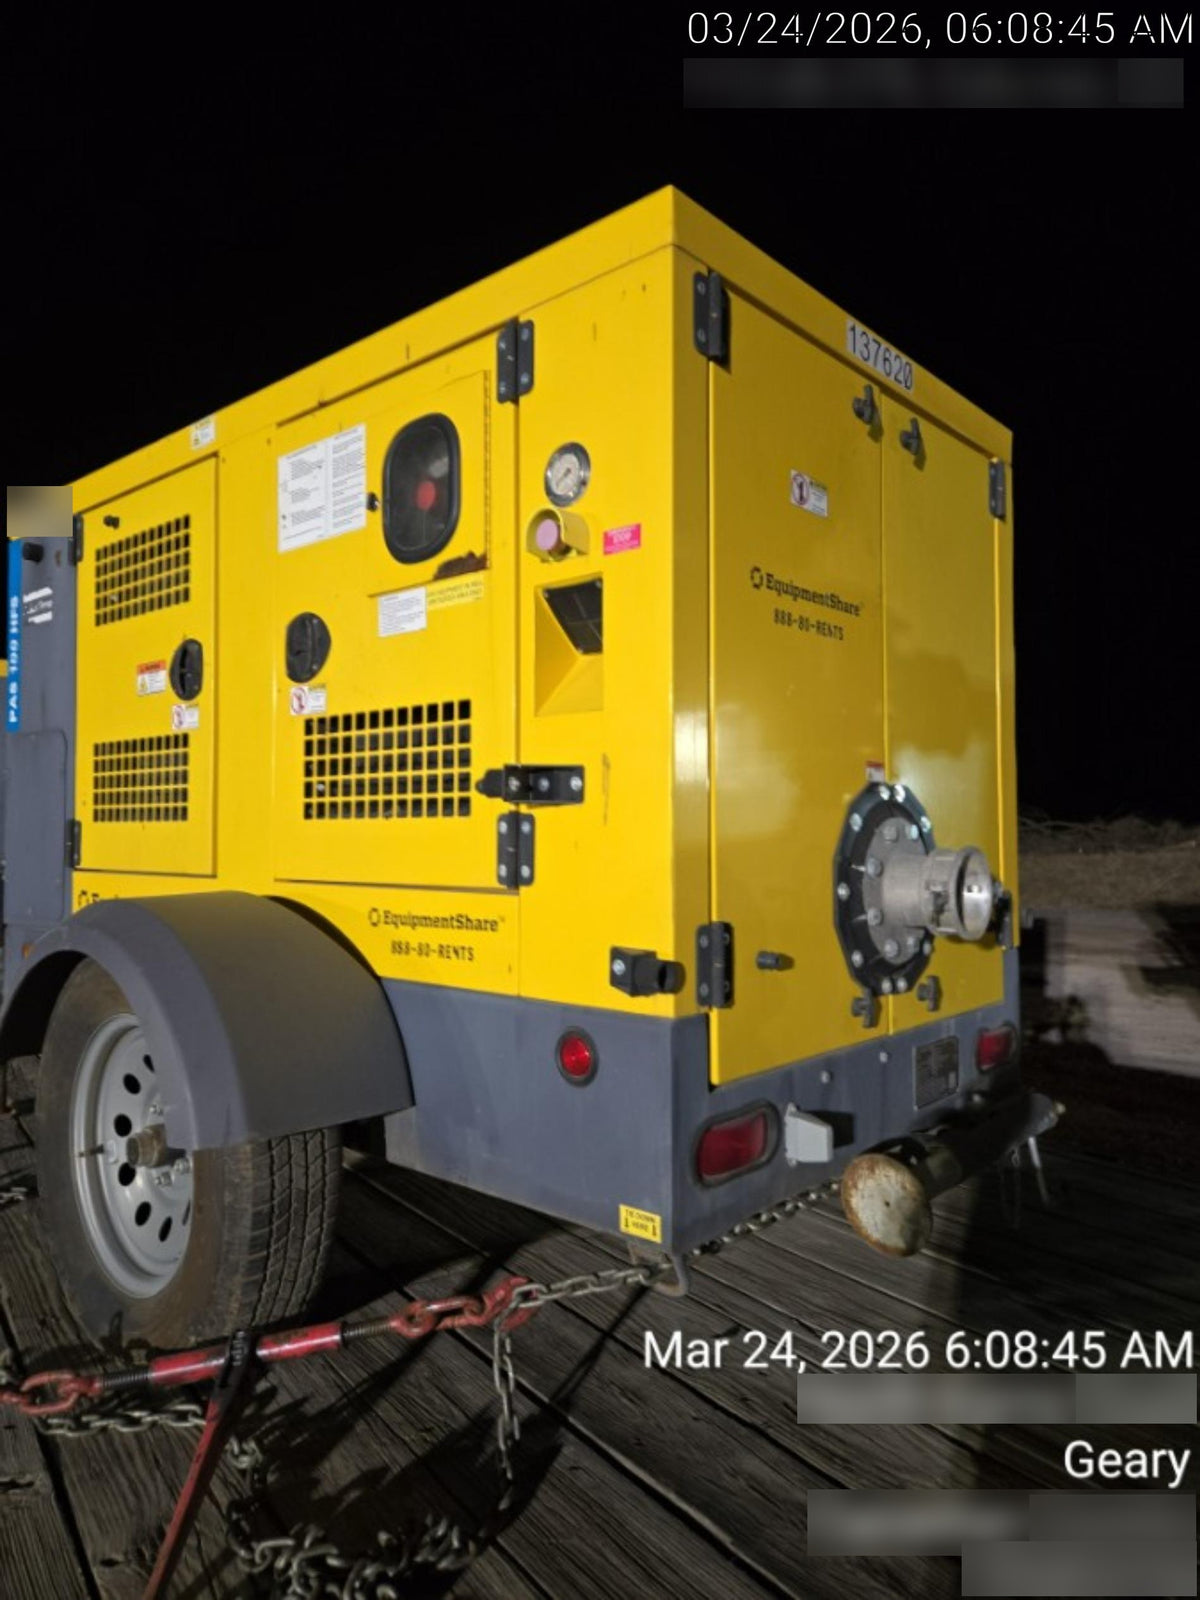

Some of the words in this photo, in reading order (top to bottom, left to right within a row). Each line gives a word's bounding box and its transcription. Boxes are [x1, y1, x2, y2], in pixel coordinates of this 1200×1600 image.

[850, 324, 912, 390] 137620
[766, 571, 861, 617] EquipmentShare
[383, 909, 499, 932] EquipmentShare
